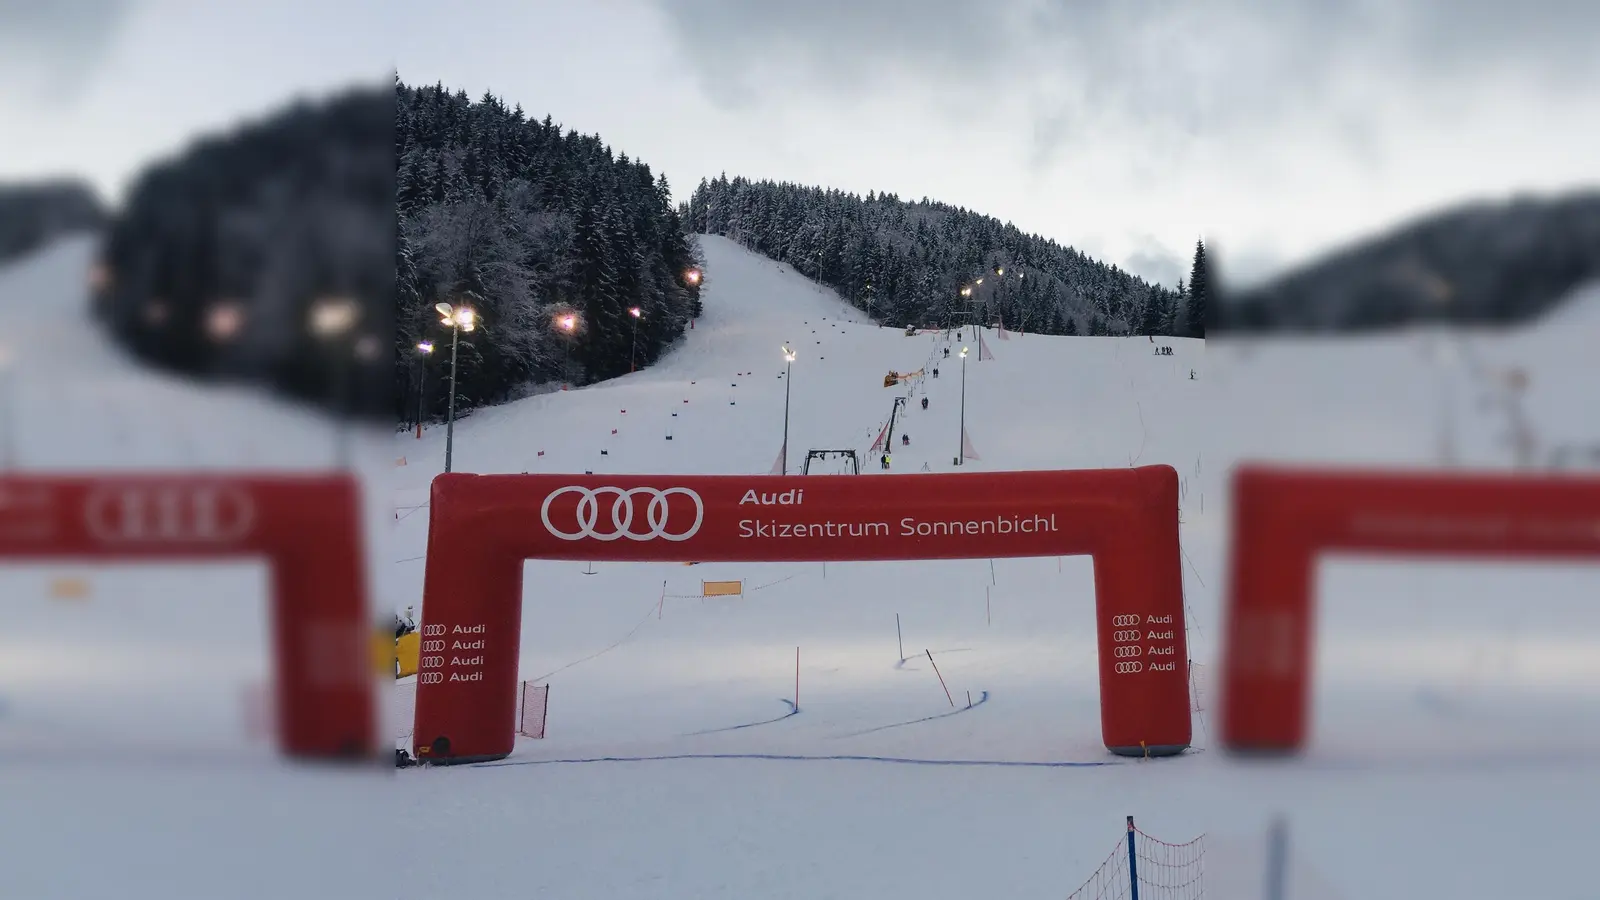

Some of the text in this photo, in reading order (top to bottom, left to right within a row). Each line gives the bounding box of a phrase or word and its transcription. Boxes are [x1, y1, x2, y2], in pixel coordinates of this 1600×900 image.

[739, 489, 803, 505] Audi
[739, 514, 1058, 537] Skizentrum Sonnenbichl
[1147, 614, 1173, 624] Audi
[452, 624, 486, 634] Audi
[1148, 630, 1174, 640] Audi
[452, 639, 485, 650] Audi
[1148, 645, 1175, 655] Audi
[451, 655, 484, 666] Audi
[1149, 661, 1176, 671] Audi
[449, 671, 483, 682] Audi
